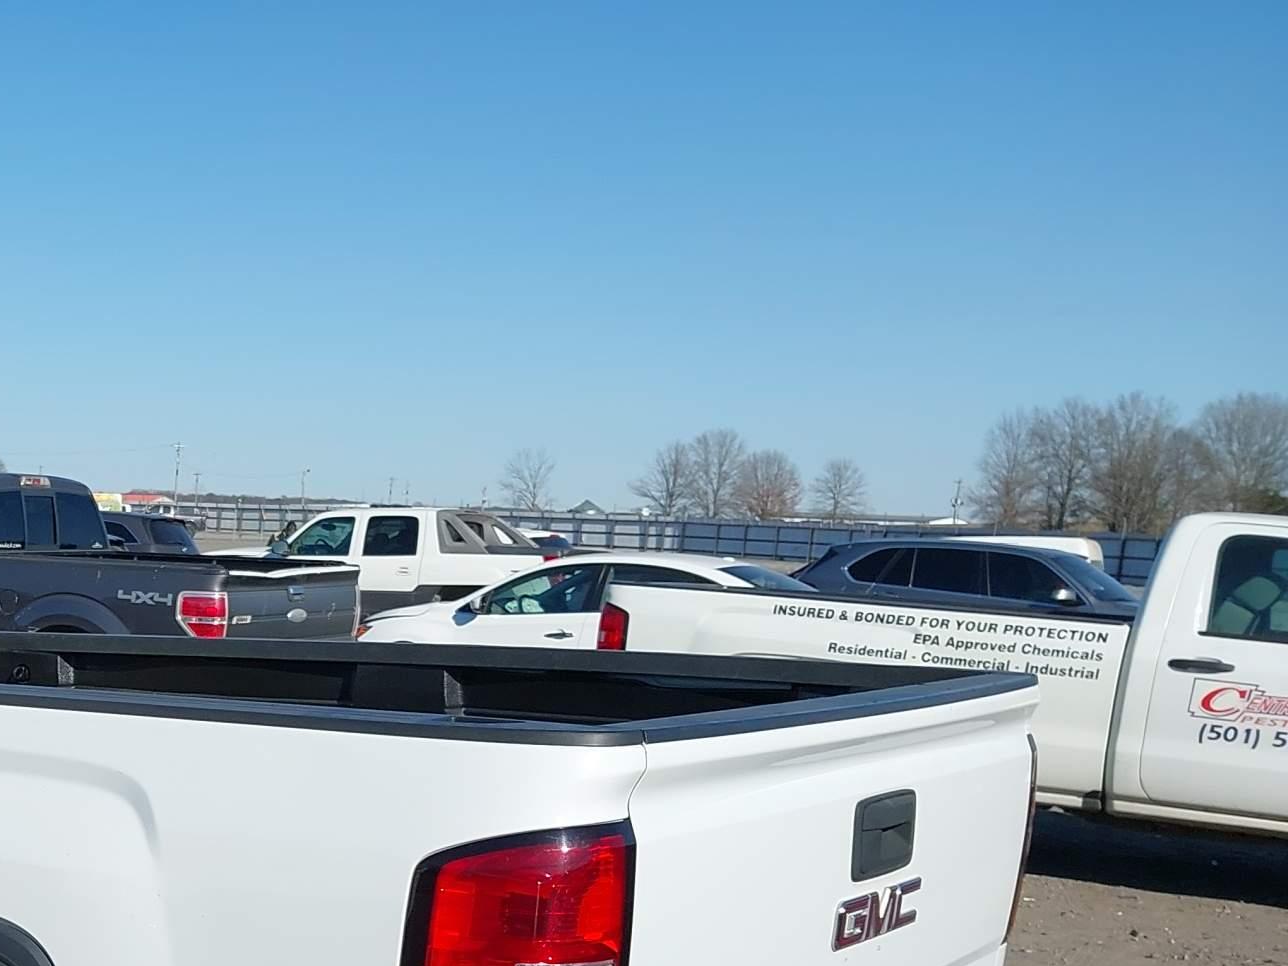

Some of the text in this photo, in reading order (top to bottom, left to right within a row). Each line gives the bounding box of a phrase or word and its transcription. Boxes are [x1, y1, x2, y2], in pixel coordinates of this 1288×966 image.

[772, 604, 1110, 643] INSURED & BONDED FOR YOUR PROTECTION
[827, 642, 908, 660] Residential
[921, 651, 1011, 671] Commercial
[1024, 661, 1100, 681] Industrial
[912, 633, 1104, 662] EPA Approved Chemicals
[1198, 723, 1260, 750] (501)
[831, 877, 922, 952] GMC
